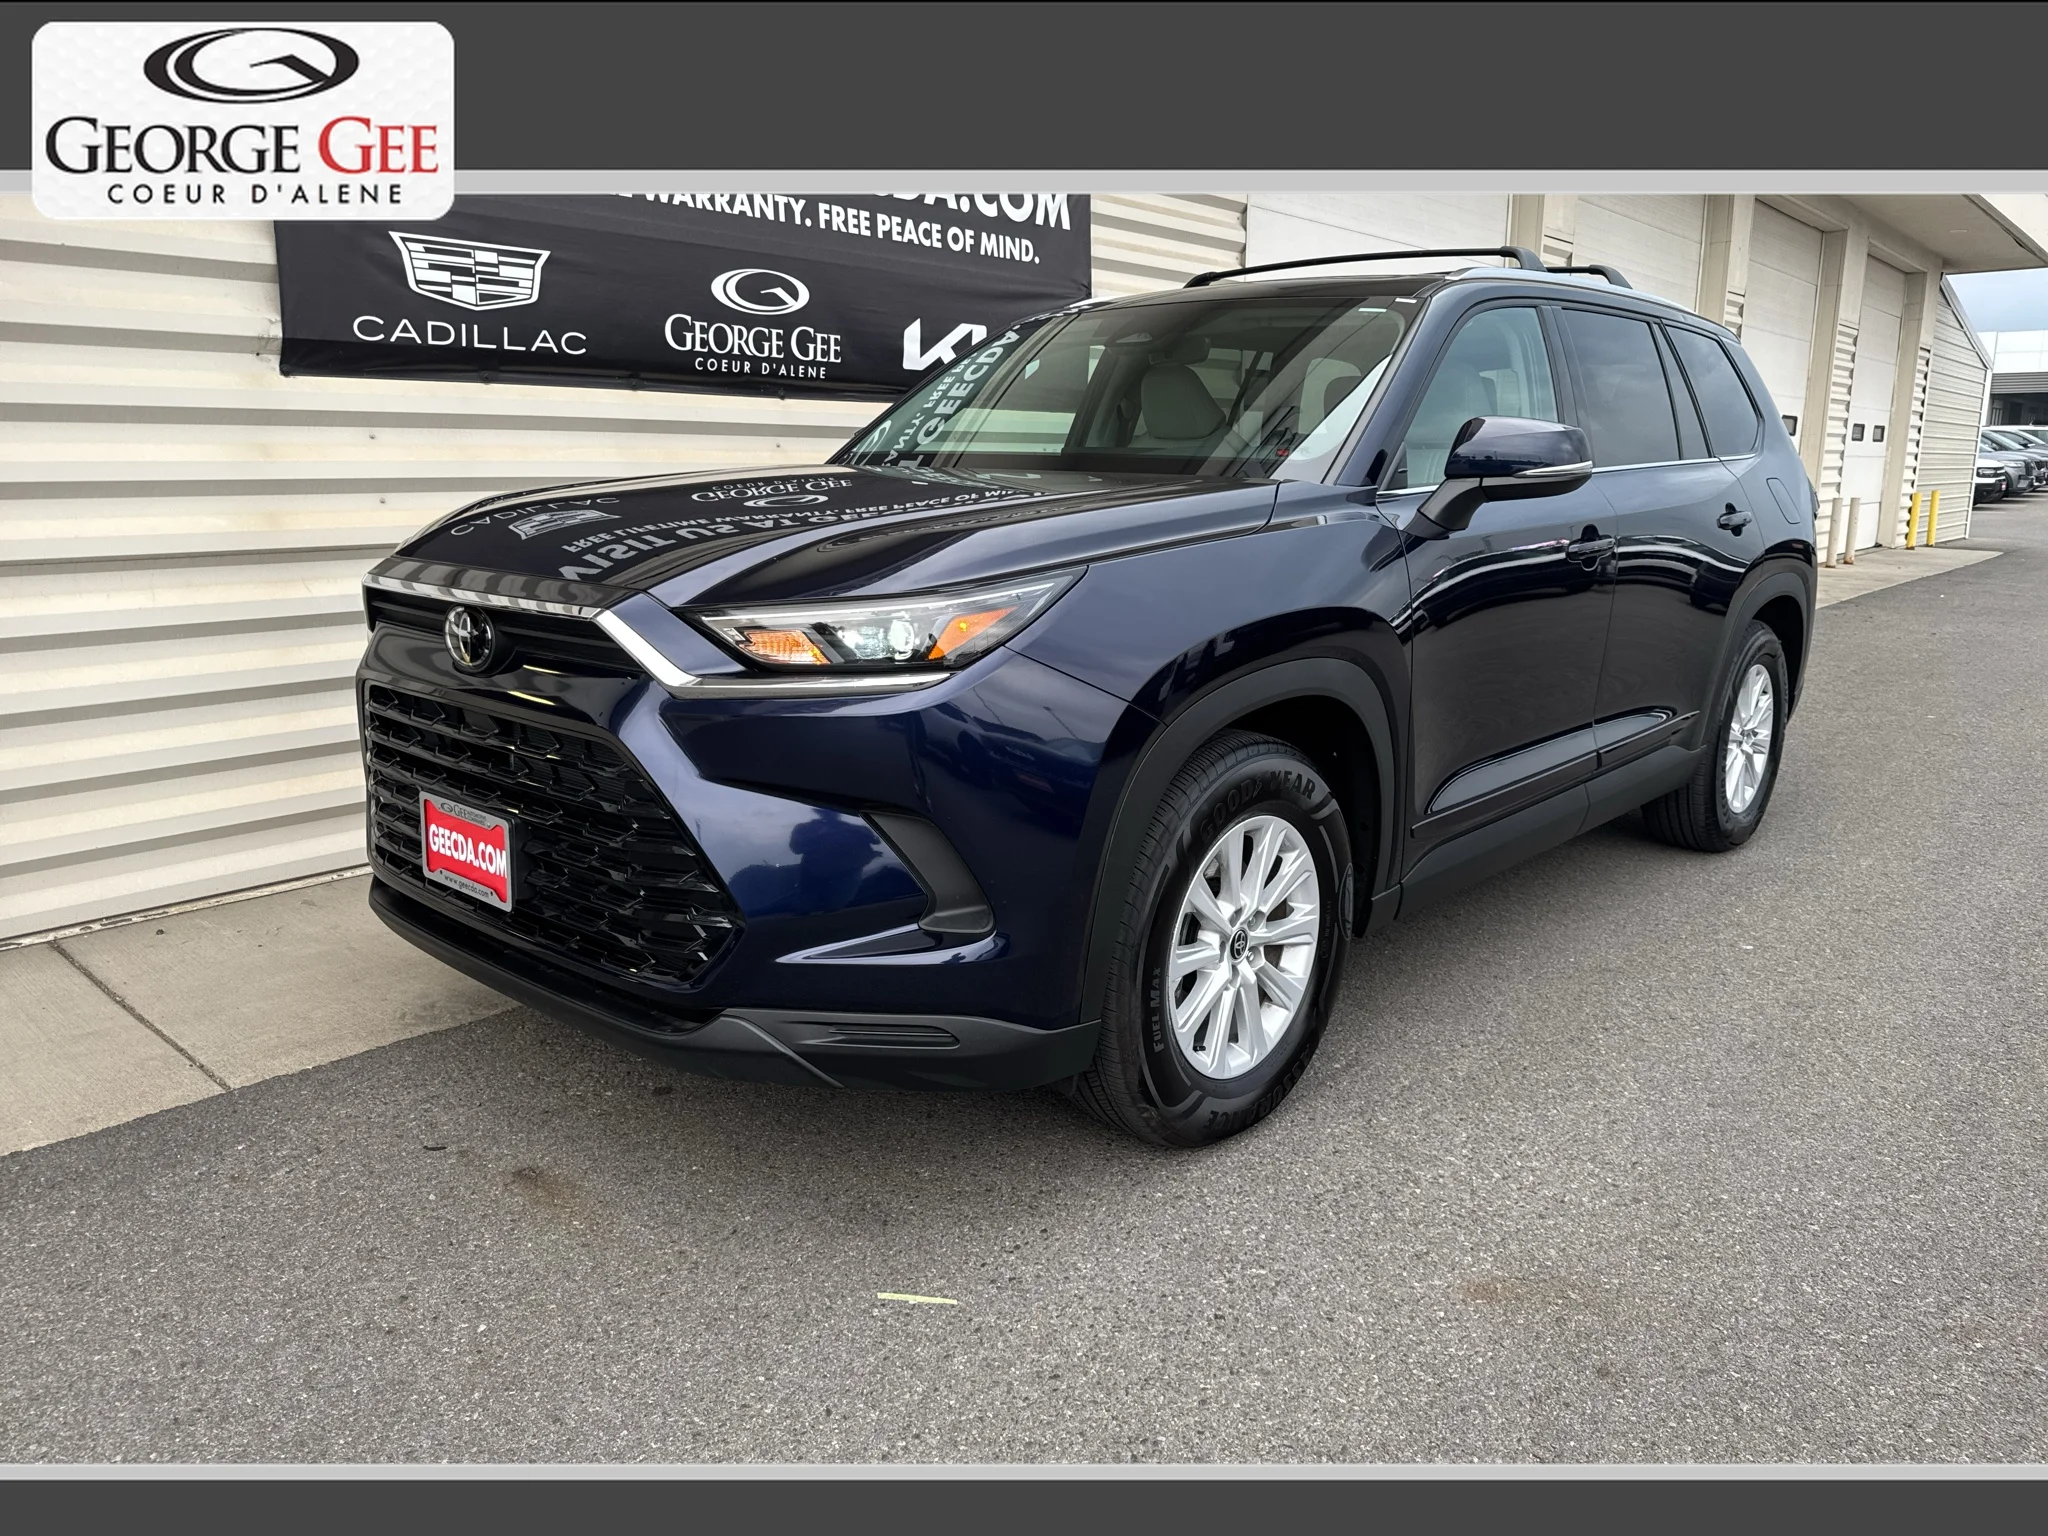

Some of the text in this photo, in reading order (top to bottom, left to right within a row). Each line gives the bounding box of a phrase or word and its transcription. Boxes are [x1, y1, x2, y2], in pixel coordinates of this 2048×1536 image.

[818, 202, 872, 237] FREE
[876, 213, 943, 249] PEACE
[947, 226, 975, 253] OF
[980, 232, 1040, 265] MIND.
[352, 314, 587, 356] CADILLAC
[664, 313, 842, 363] GEORGE GEE
[695, 357, 827, 379] COEUR D'ALENE
[429, 823, 507, 879] GEECDA.COM
